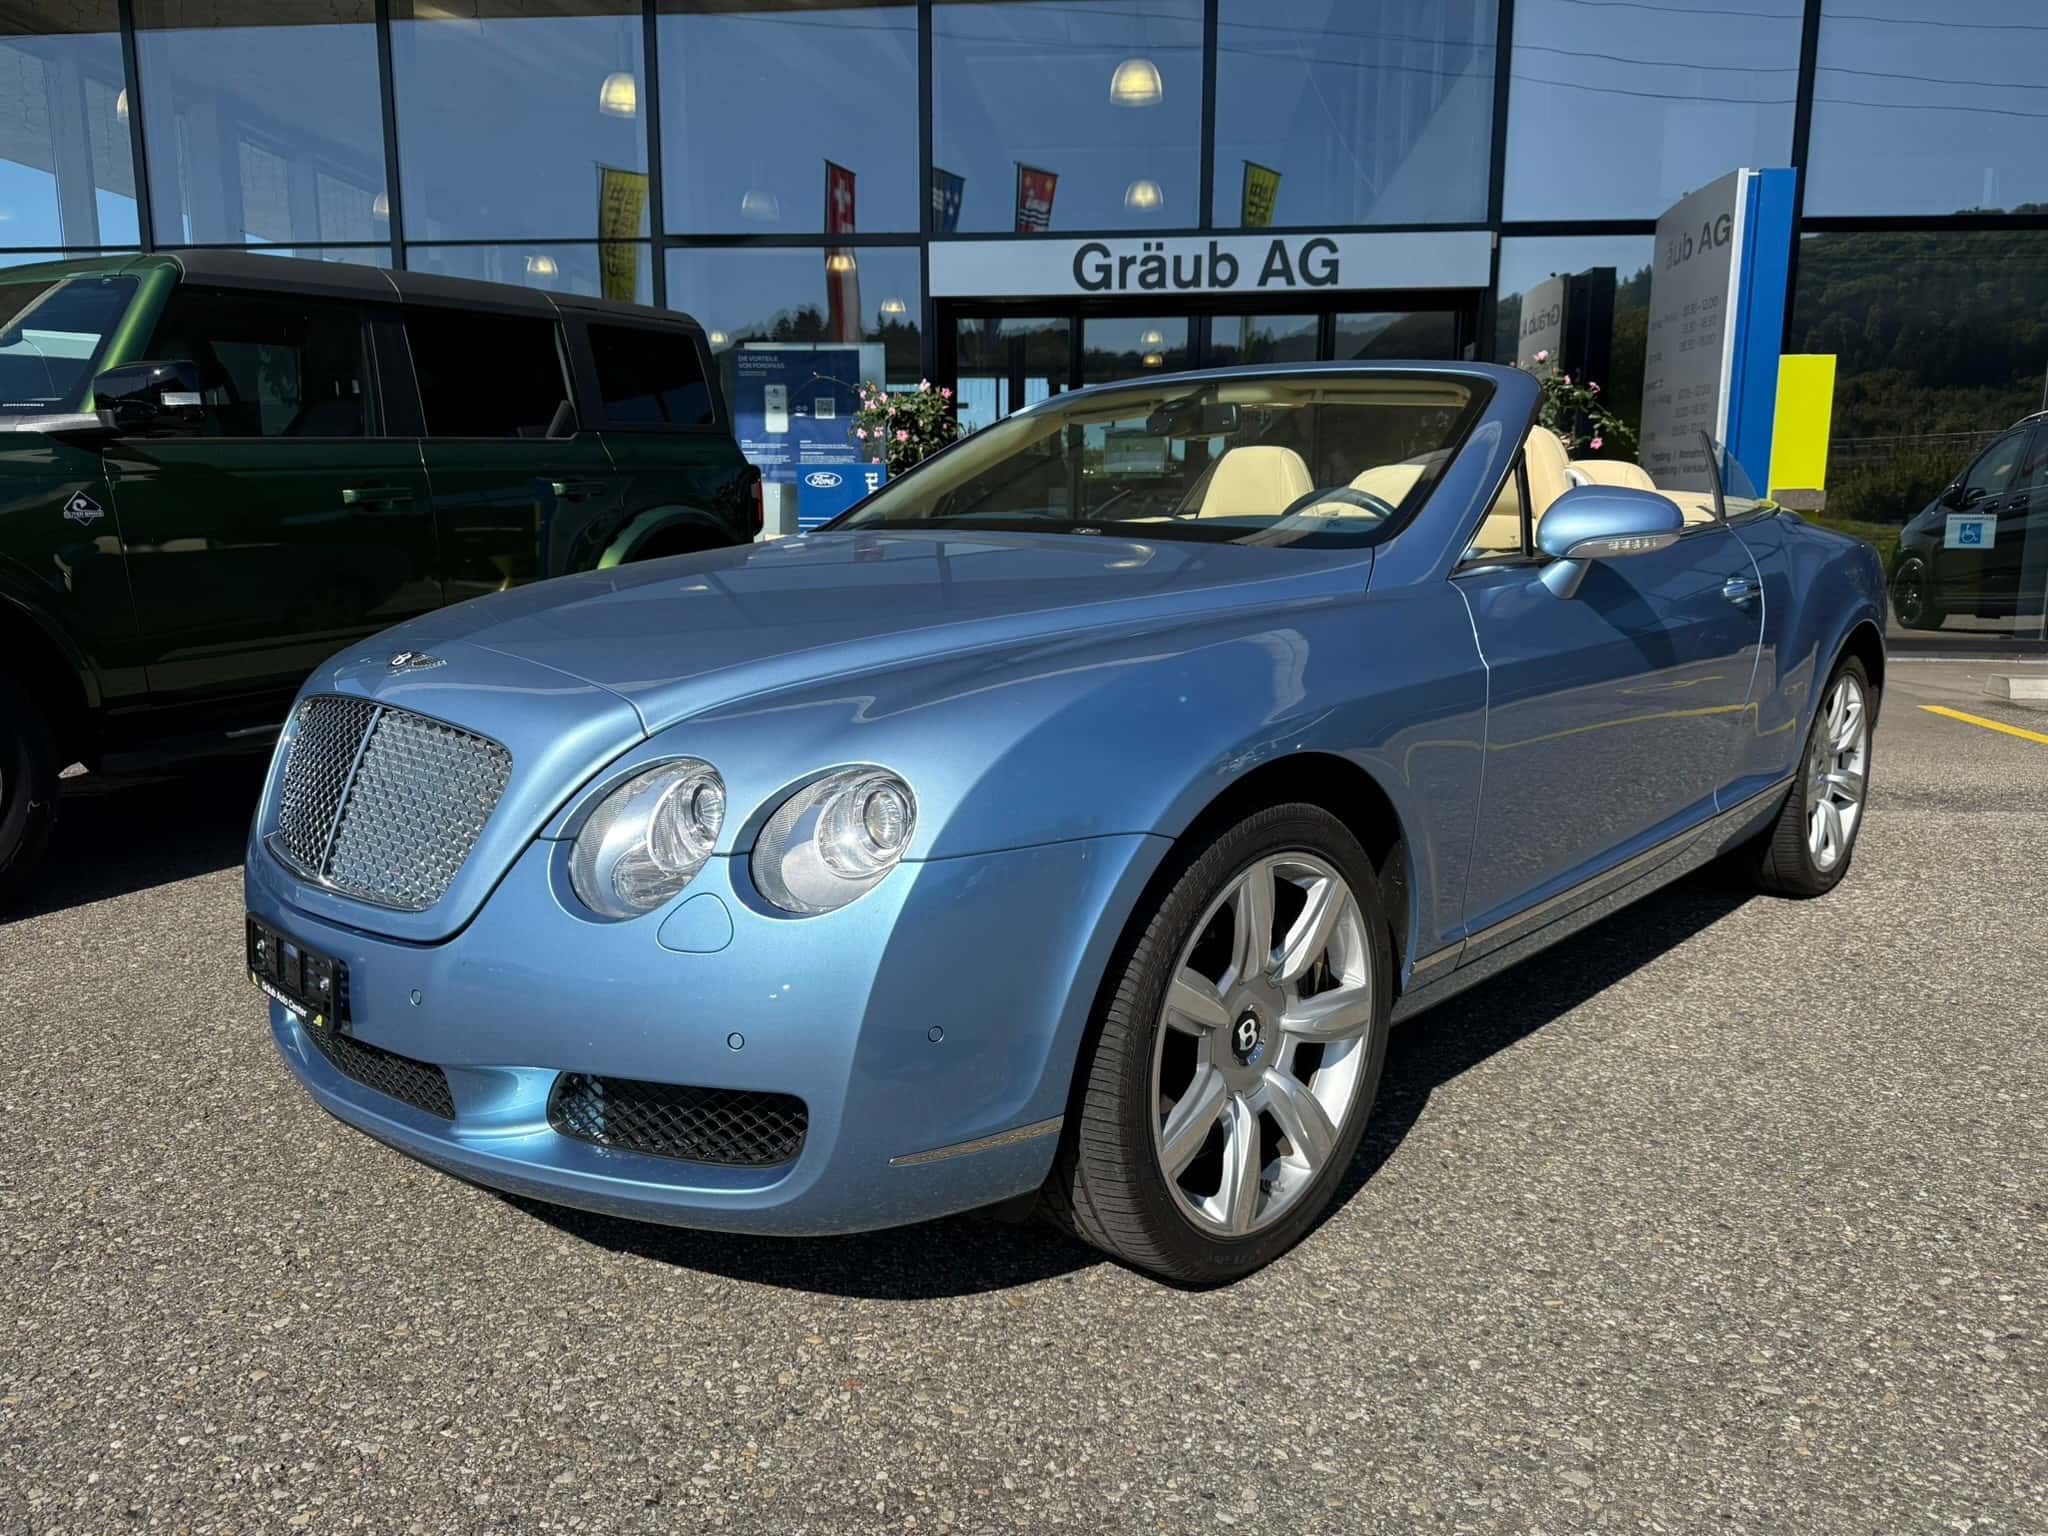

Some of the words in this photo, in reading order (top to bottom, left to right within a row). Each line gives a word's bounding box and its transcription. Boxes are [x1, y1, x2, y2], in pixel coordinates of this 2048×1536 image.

[1698, 213, 1731, 255] AG
[1073, 240, 1239, 291] Gräub
[1257, 237, 1340, 287] AG
[1238, 1018, 1257, 1051] B
